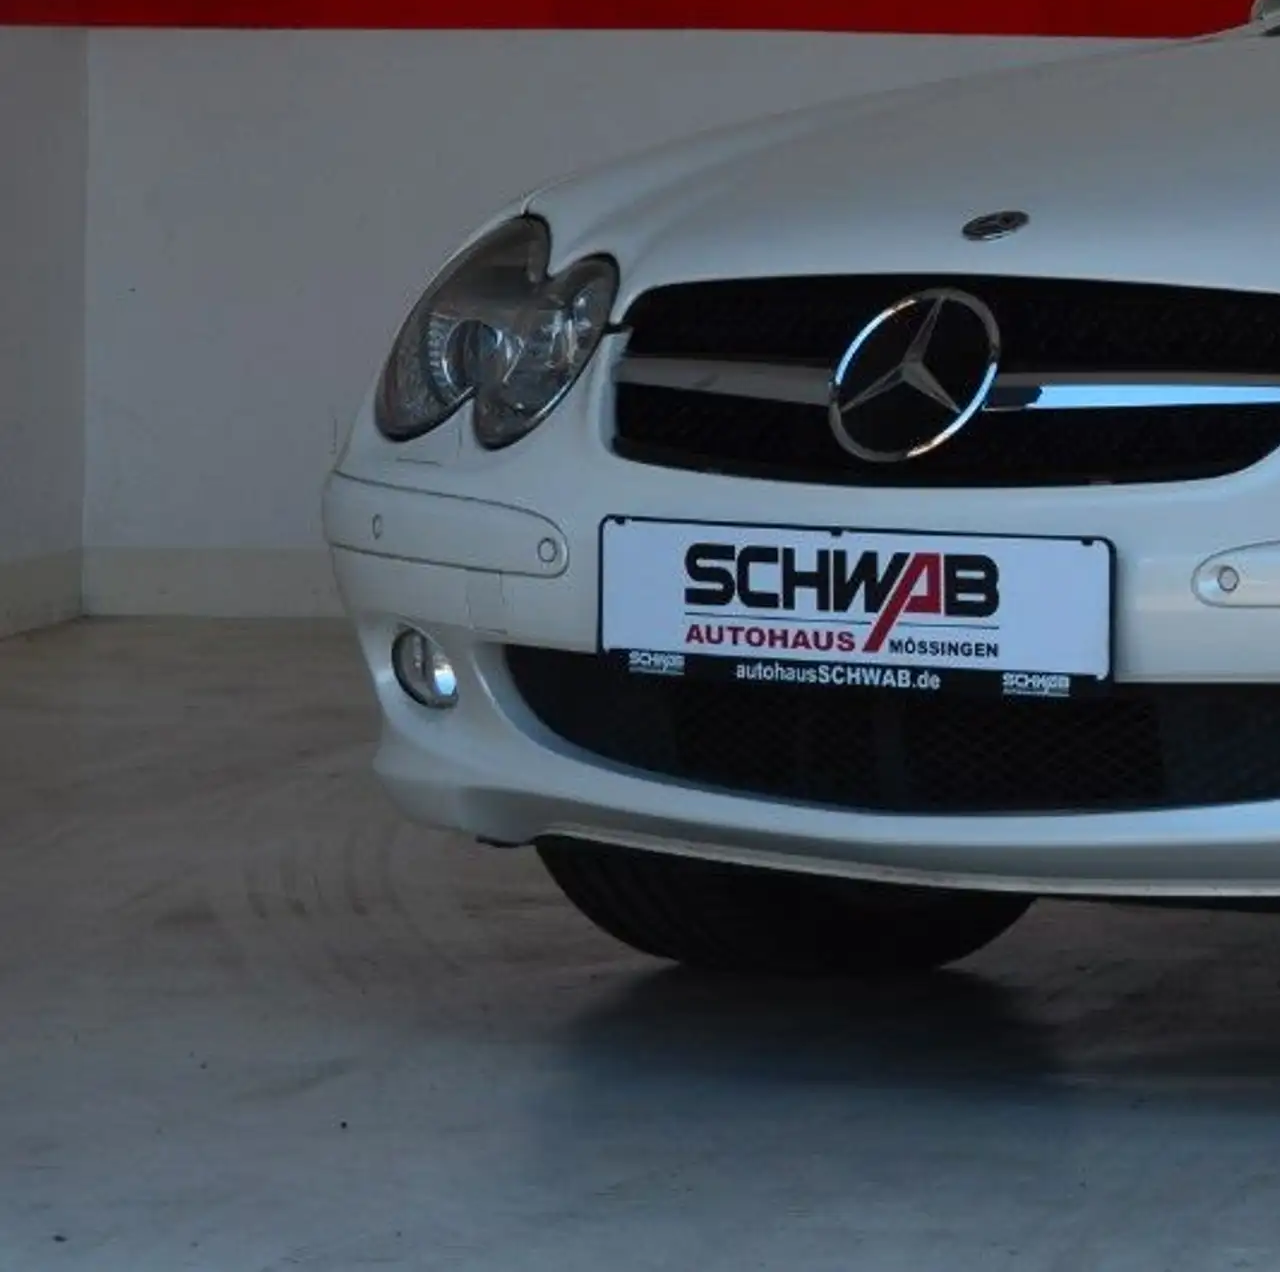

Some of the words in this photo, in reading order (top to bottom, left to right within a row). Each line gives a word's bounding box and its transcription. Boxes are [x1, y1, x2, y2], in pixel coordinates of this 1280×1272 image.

[684, 542, 1000, 652] SCHWAB
[685, 623, 855, 652] AUTOHAUS
[888, 635, 999, 658] MÖSSINGEN
[735, 661, 941, 691] autohausSCHWAB.de
